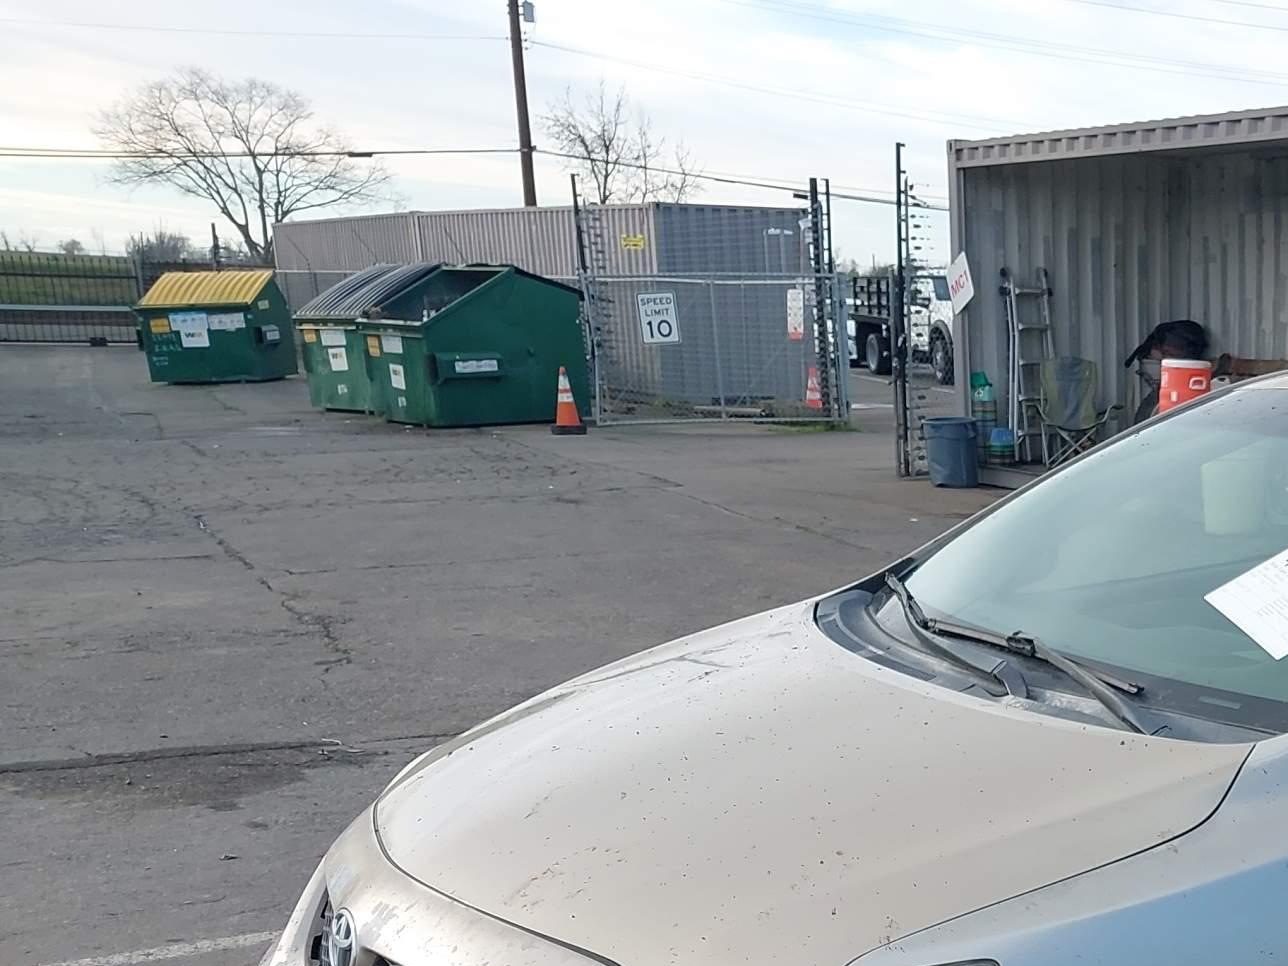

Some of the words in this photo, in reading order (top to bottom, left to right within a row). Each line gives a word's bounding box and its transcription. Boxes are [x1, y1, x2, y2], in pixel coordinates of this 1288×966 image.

[640, 297, 672, 306] SPEED
[645, 308, 669, 317] LIMIT
[647, 320, 672, 339] 10
